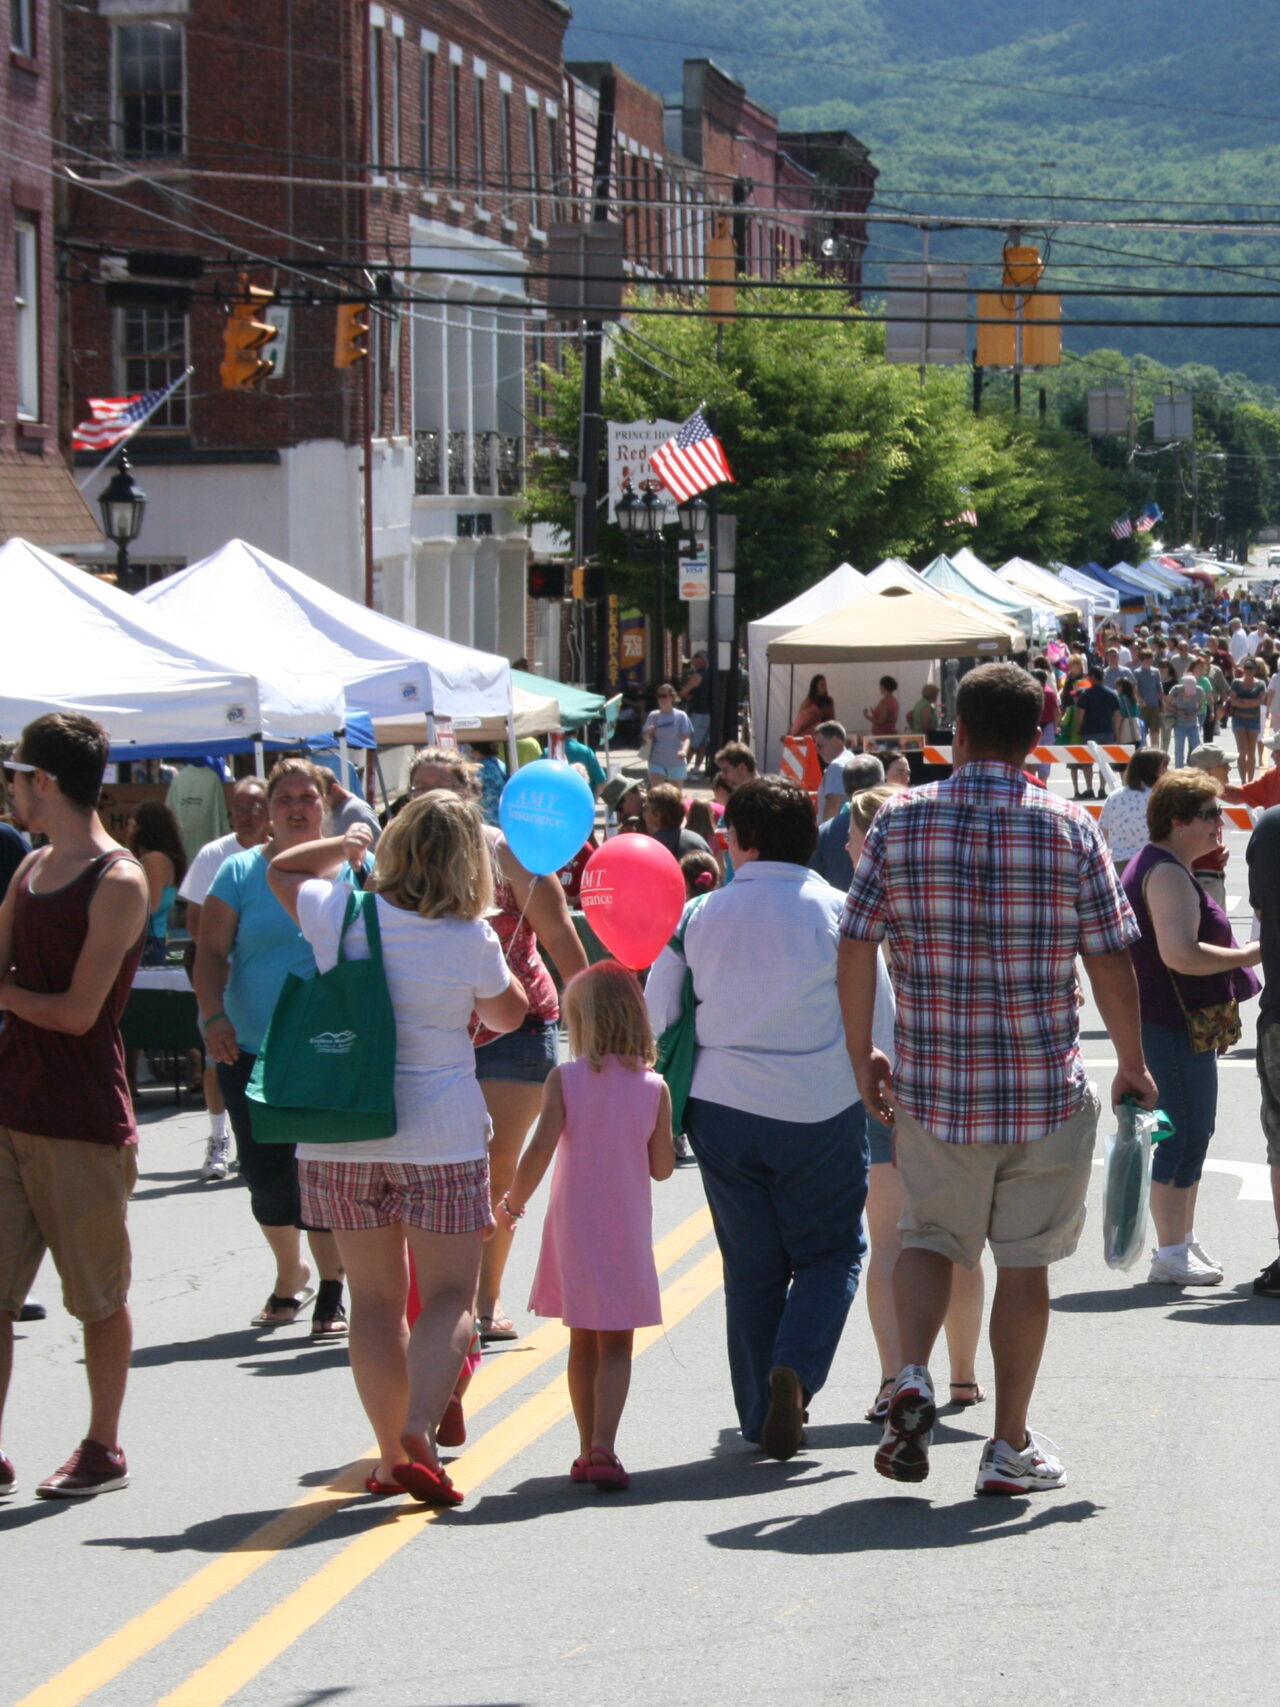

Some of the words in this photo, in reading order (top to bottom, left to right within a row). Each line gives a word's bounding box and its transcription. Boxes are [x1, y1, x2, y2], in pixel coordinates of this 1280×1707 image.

[615, 431, 651, 440] PRINCE
[616, 443, 647, 461] Red
[516, 790, 561, 809] AMT
[508, 808, 563, 827] Insurance
[581, 869, 606, 888] MT
